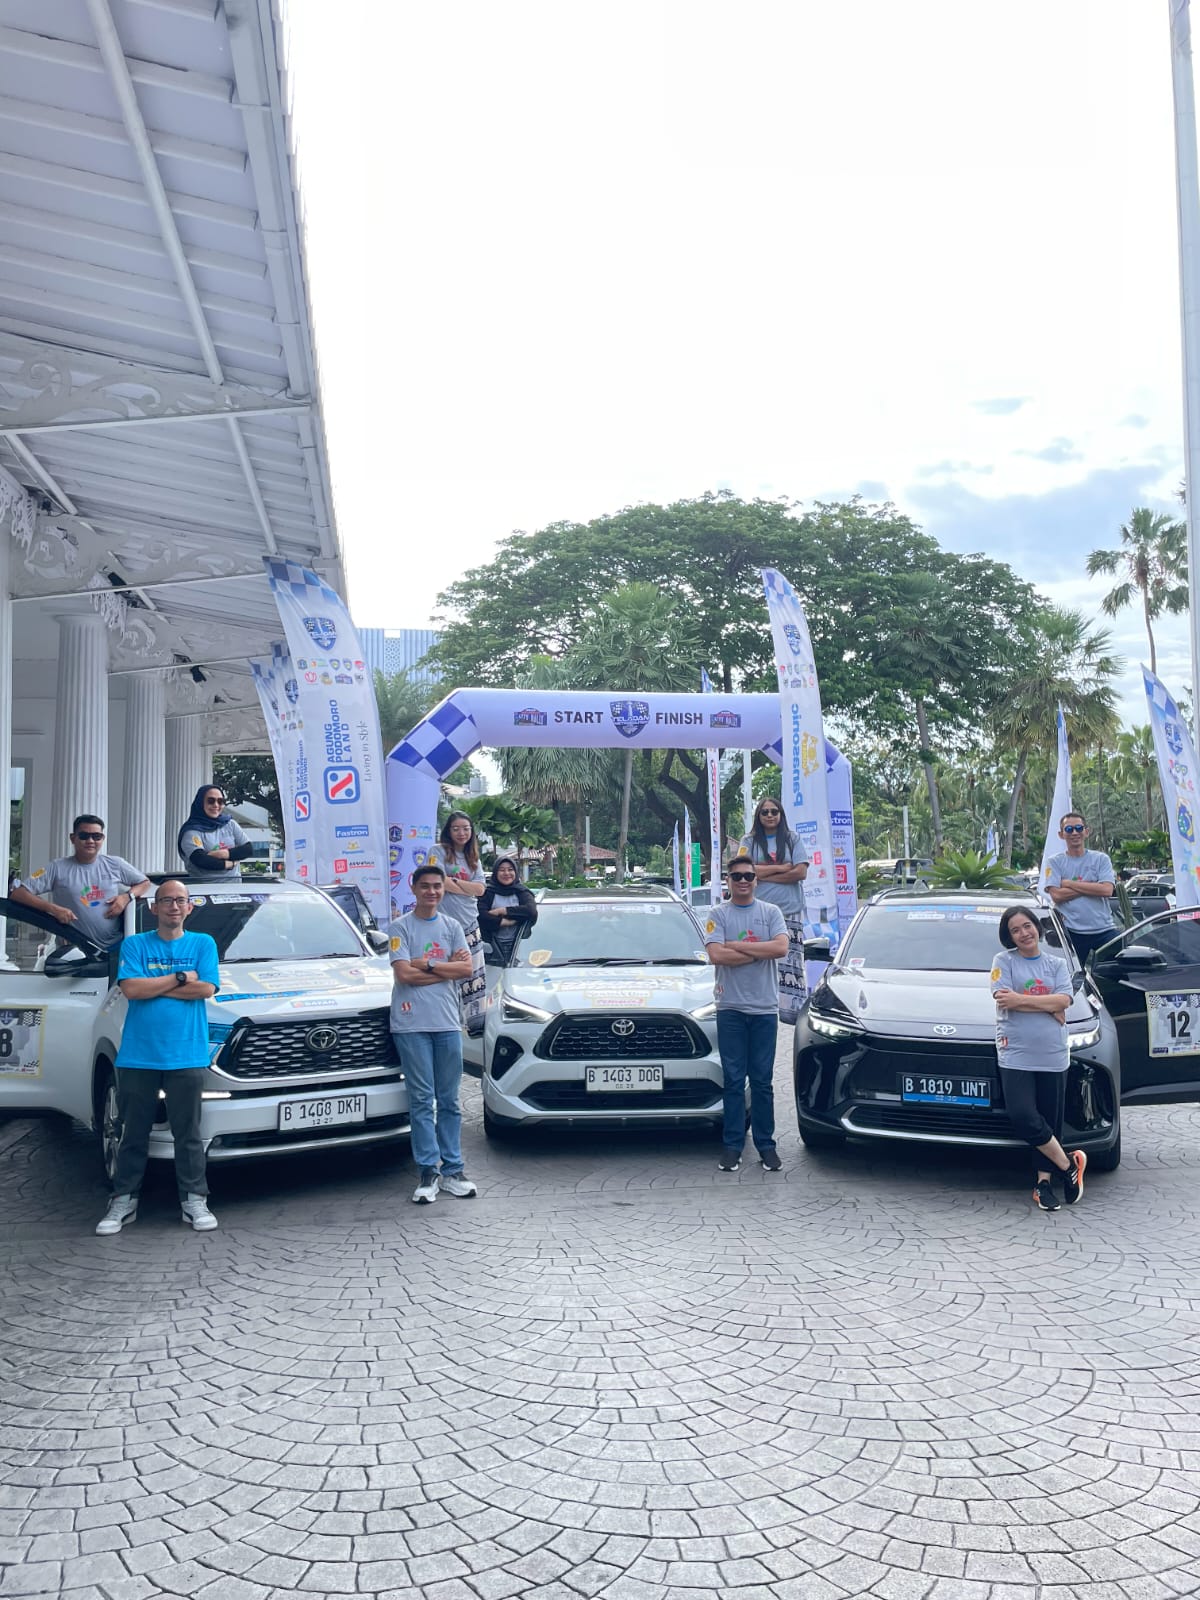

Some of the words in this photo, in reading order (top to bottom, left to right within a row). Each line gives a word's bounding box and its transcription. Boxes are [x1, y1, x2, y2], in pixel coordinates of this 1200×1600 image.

[554, 710, 604, 724] START
[655, 712, 703, 725] FINISH
[329, 699, 344, 763] PODOMORO
[355, 720, 368, 741] Style
[324, 723, 335, 763] AGUNG
[341, 723, 352, 763] LAND
[362, 743, 369, 752] in
[362, 754, 372, 782] Living
[336, 829, 368, 837] Fastron
[1167, 1010, 1190, 1038] 12
[0, 1028, 13, 1058] 8
[588, 1069, 595, 1083] B
[602, 1069, 632, 1083] 1403
[638, 1068, 660, 1082] DOG
[905, 1078, 914, 1093] B
[919, 1079, 953, 1095] 1819
[961, 1081, 987, 1097] UNT
[284, 1106, 292, 1121] B
[299, 1101, 332, 1119] 1408
[337, 1096, 361, 1114] DKH
